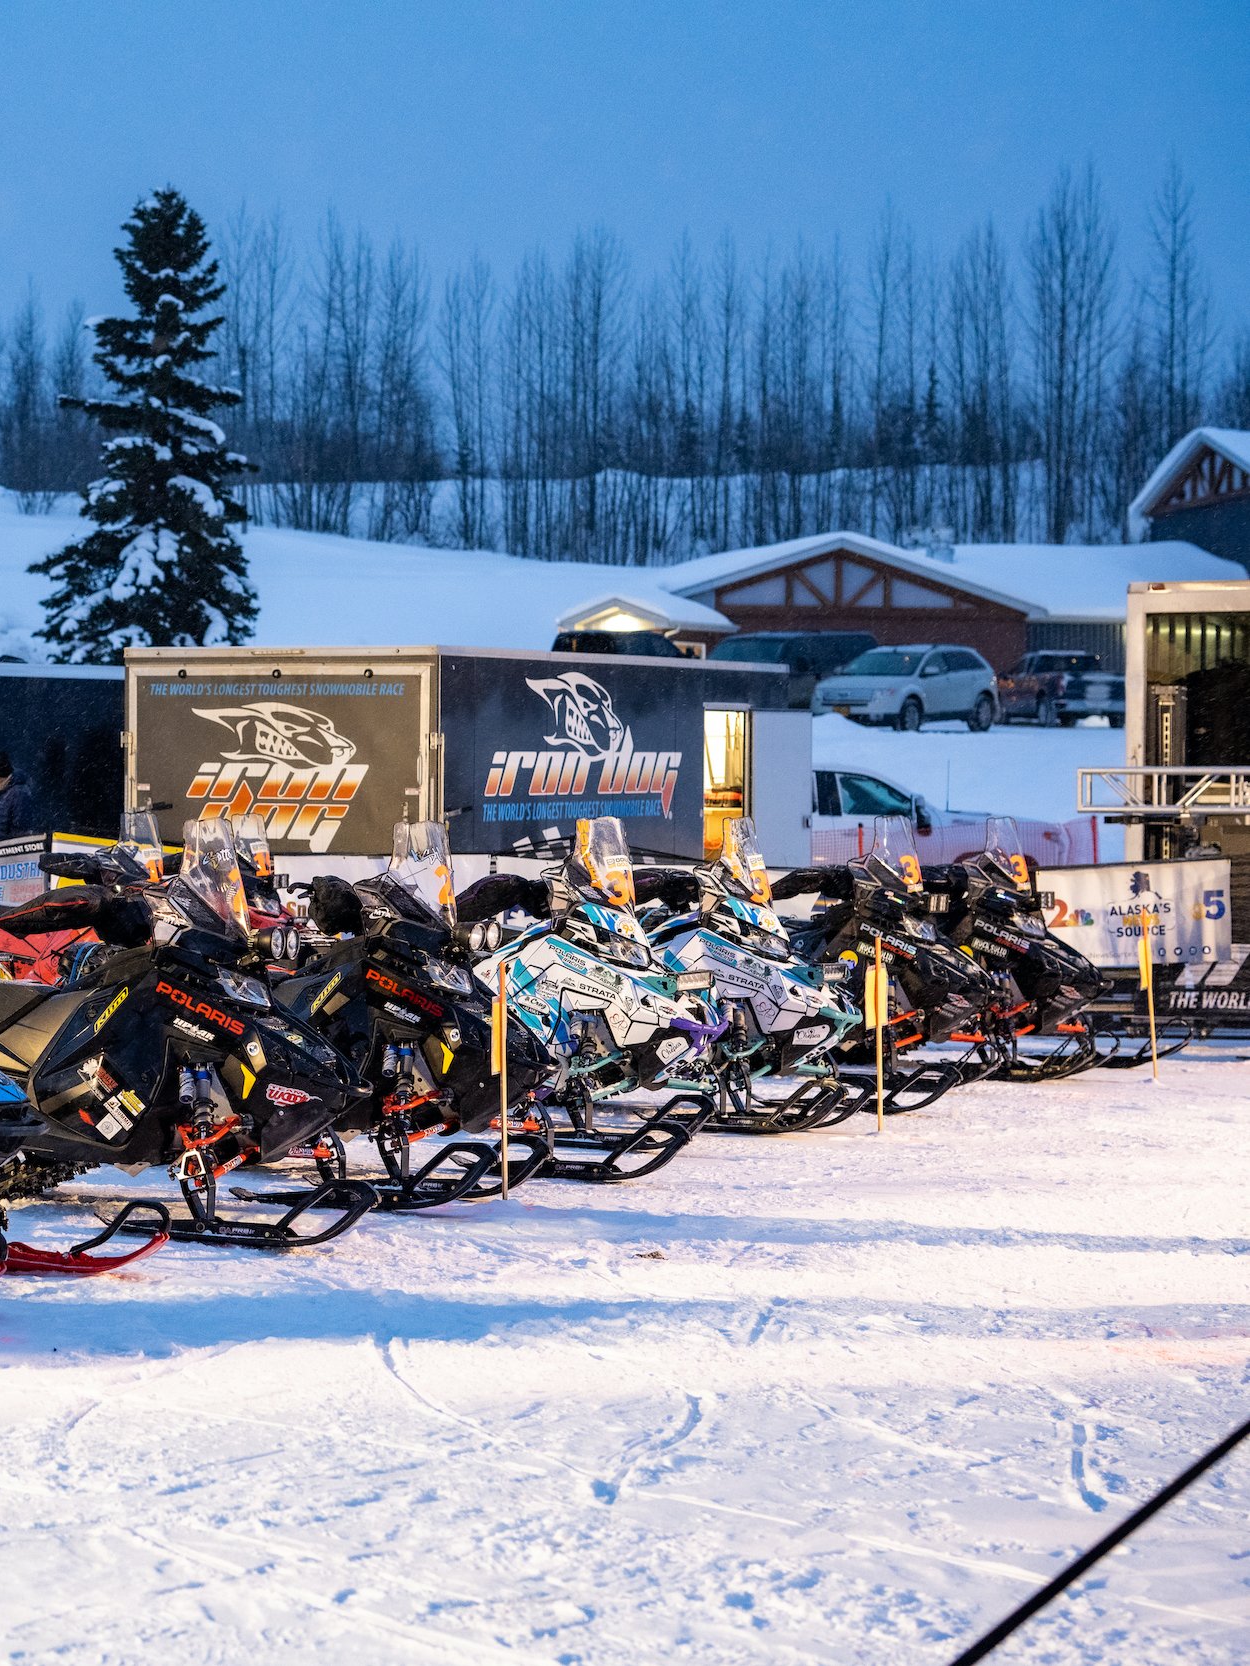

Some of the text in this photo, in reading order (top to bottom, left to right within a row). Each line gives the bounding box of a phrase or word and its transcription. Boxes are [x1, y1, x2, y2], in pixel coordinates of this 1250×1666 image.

[150, 683, 405, 696] THE WORLD'S LONGEST TOUGHEST SNOWMOBILE RACE
[483, 799, 661, 822] THE WORLD'S LONGEST TOUGHEST SNOWMOBILE RACE
[24, 842, 44, 853] STORE
[899, 855, 923, 886] 3
[1009, 854, 1029, 884] 3
[1048, 899, 1068, 928] 2
[1110, 903, 1171, 916] ALASKA'S
[1203, 890, 1226, 920] 5
[860, 923, 918, 955] POLARIS
[974, 918, 1031, 950] POLARIS
[549, 944, 586, 966] POLARIS
[699, 938, 736, 958] POLARIS
[365, 968, 444, 1017] POLARIS
[579, 983, 617, 1000] STRATA
[728, 975, 765, 990] STRATA
[156, 981, 246, 1035] POLARIS
[1169, 991, 1250, 1010] THE WORL
[269, 1089, 309, 1105] wood
[115, 1108, 133, 1128] SUMMIT
